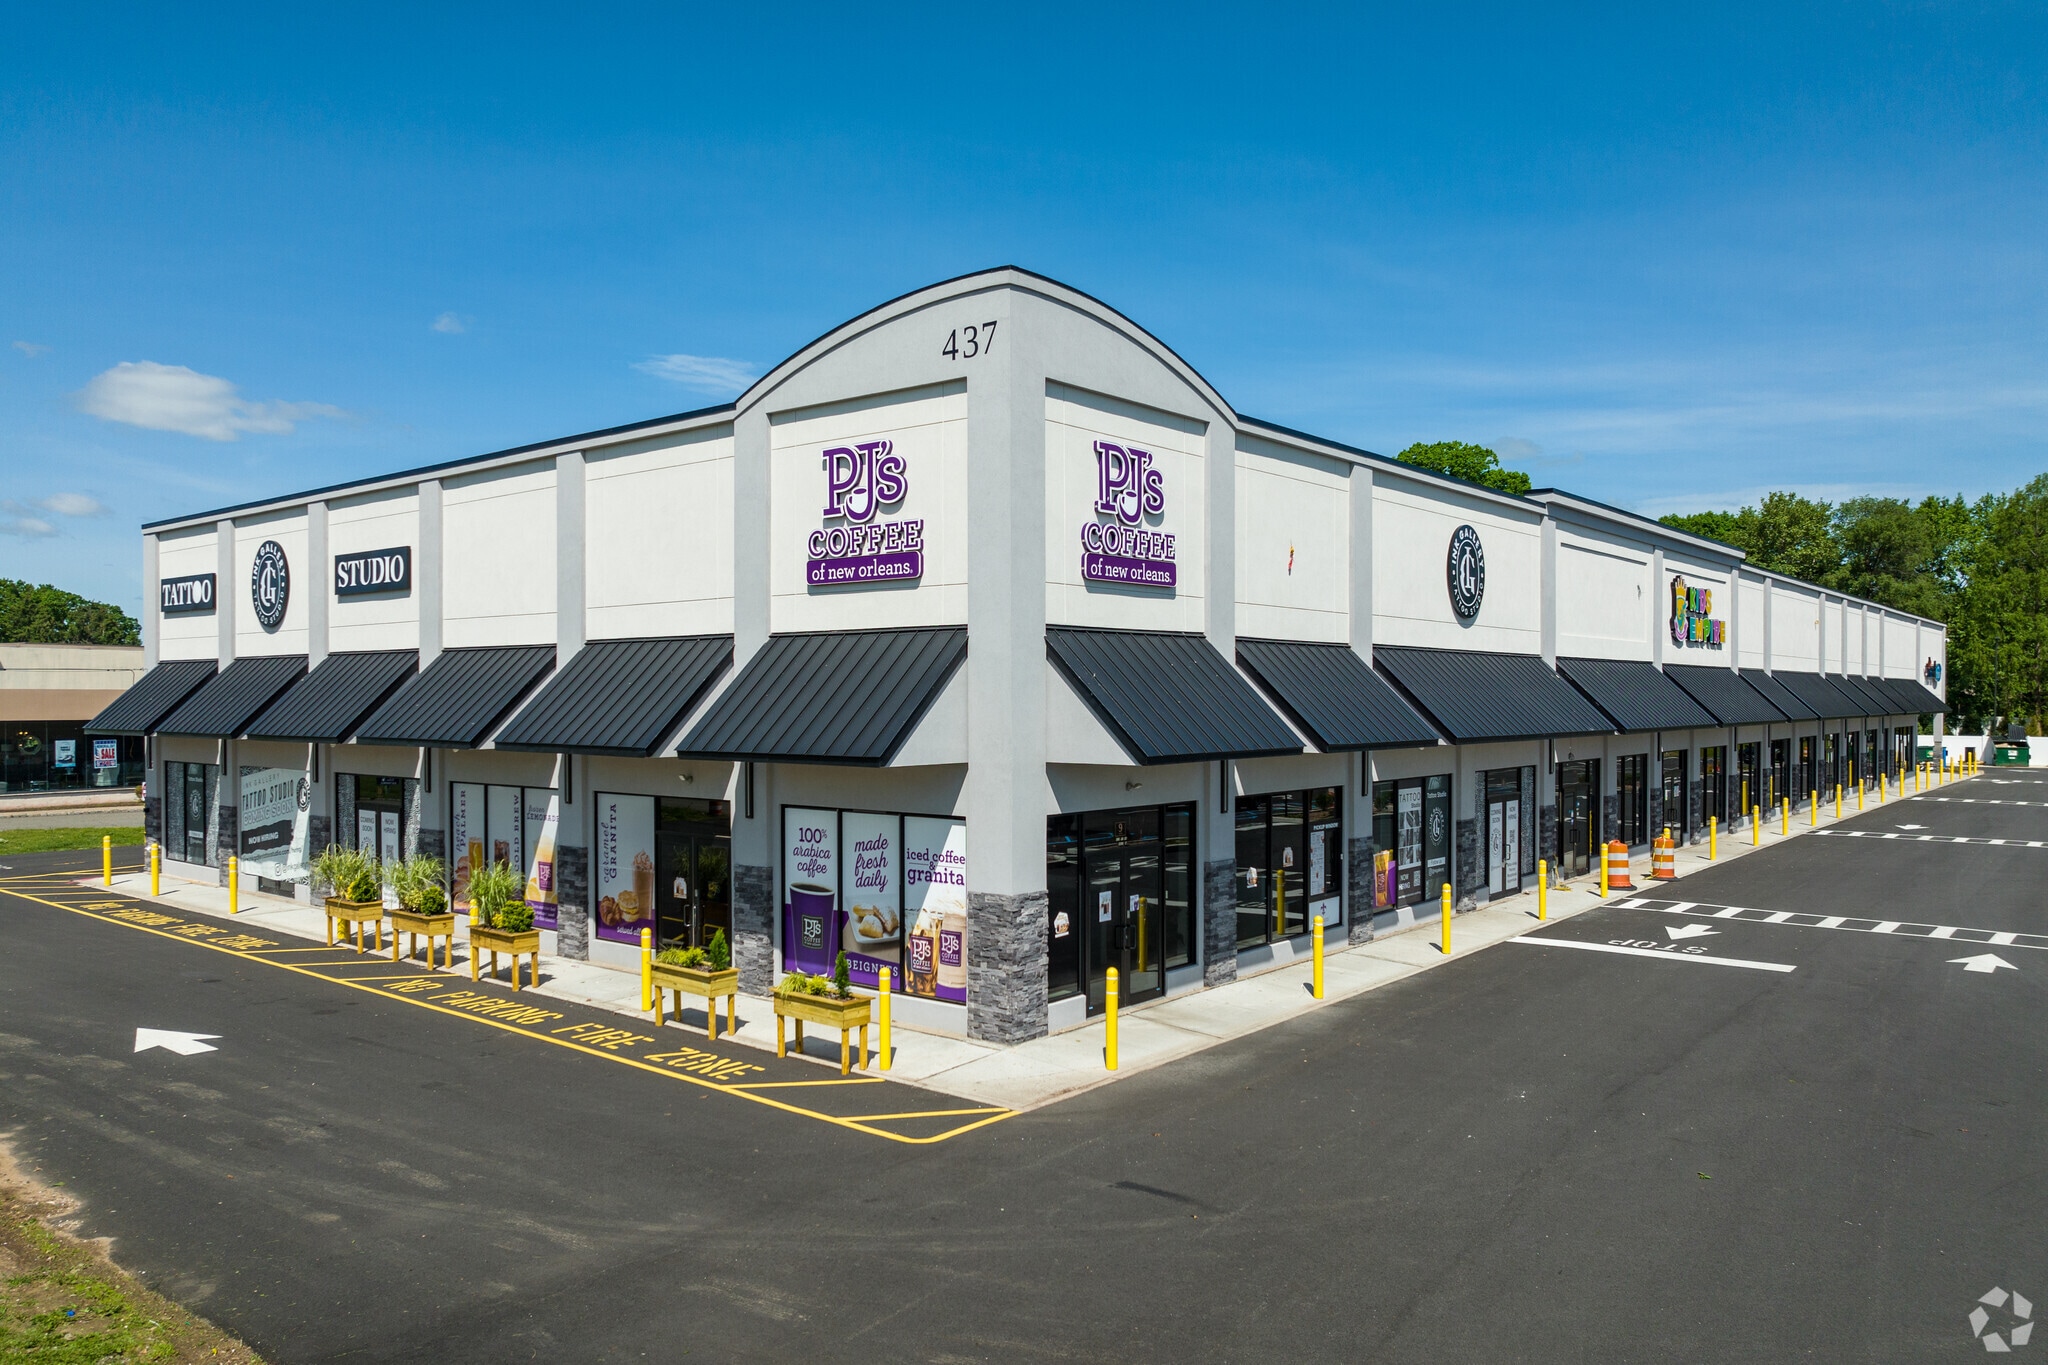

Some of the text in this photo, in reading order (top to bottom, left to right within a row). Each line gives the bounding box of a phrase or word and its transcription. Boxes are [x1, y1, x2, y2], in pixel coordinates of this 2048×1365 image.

[942, 320, 998, 361] 437
[822, 439, 909, 523] PJ's
[1093, 440, 1165, 525] PJ's
[808, 519, 924, 558] COFFEE
[1081, 522, 1176, 561] COFFEE
[1452, 527, 1484, 568] INK GALLERY
[252, 543, 286, 580] INK GALLERY
[338, 554, 404, 588] STUDIO
[811, 562, 826, 581] of
[828, 564, 855, 580] new
[1091, 558, 1103, 575] of
[1105, 565, 1128, 579] new
[163, 580, 211, 606] TATTOO
[1688, 587, 1712, 615] KIDS
[253, 592, 285, 624] TATTOO STUDIO
[1688, 617, 1726, 645] EMPIRE
[101, 748, 115, 760] SALE
[242, 788, 267, 811] TATTOO
[270, 779, 294, 803] STUDIO
[1399, 791, 1421, 803] TATTOO
[453, 814, 462, 852] peach
[798, 827, 828, 844] 100%
[854, 833, 889, 852] made
[601, 822, 610, 883] caramel
[793, 845, 831, 860] arabica
[855, 850, 888, 877] fresh
[906, 848, 966, 865] iced coffee
[797, 859, 827, 878] coffee
[907, 868, 965, 886] granita
[928, 862, 936, 871] &
[855, 869, 889, 893] daily
[80, 902, 280, 950] NO PARKING FIRE ZONE
[941, 952, 960, 960] COFFEE
[1607, 939, 1708, 954] STOP
[912, 959, 931, 967] COFFEE
[382, 978, 766, 1081] NO PARKING FIRE ZONE
